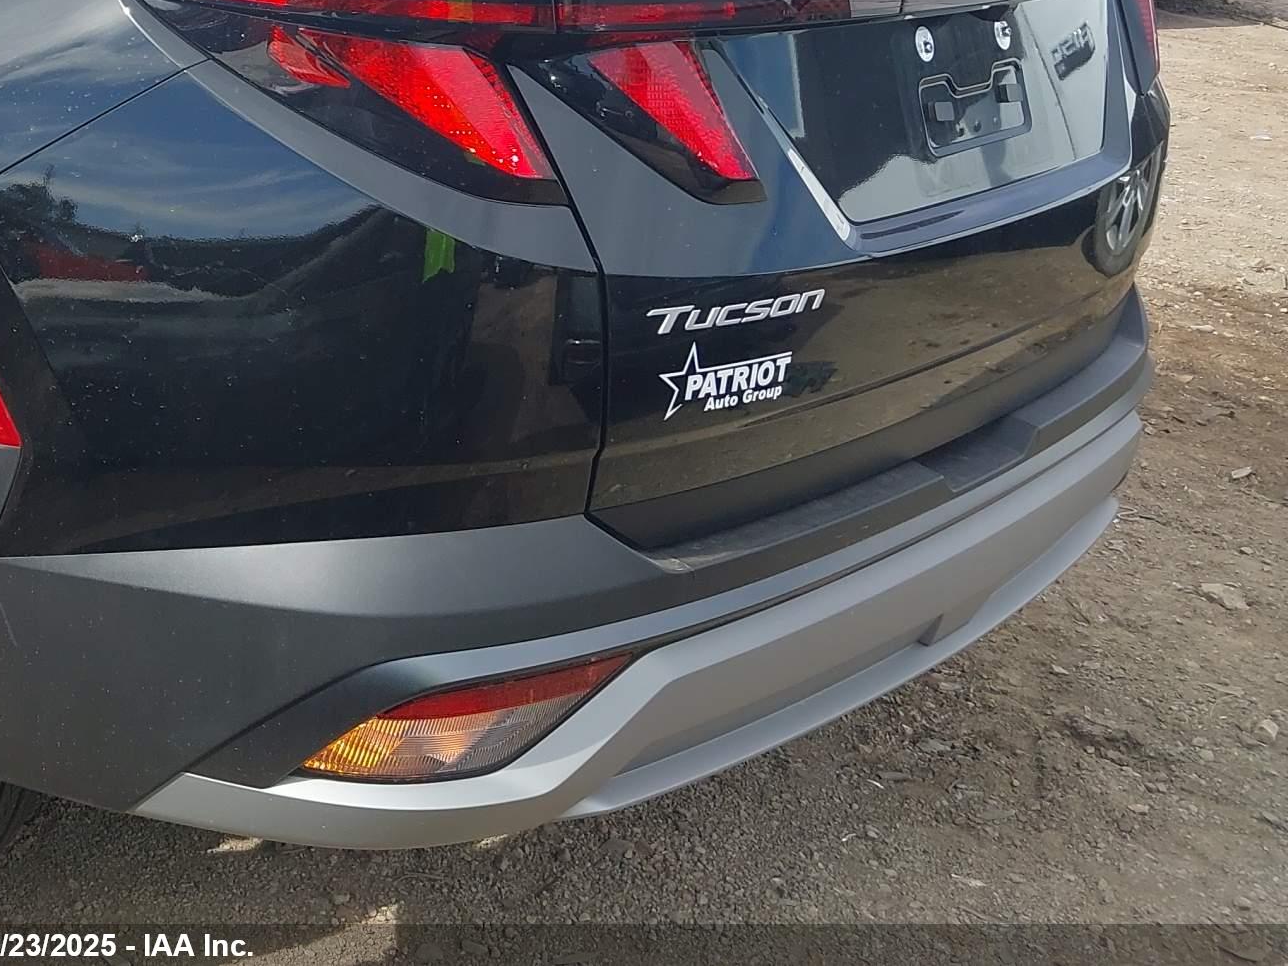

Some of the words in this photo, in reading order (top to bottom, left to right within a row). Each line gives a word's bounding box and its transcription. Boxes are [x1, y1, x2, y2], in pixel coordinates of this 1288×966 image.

[684, 356, 792, 401] PATRIOT
[703, 395, 738, 412] Auto
[742, 385, 783, 404] Group
